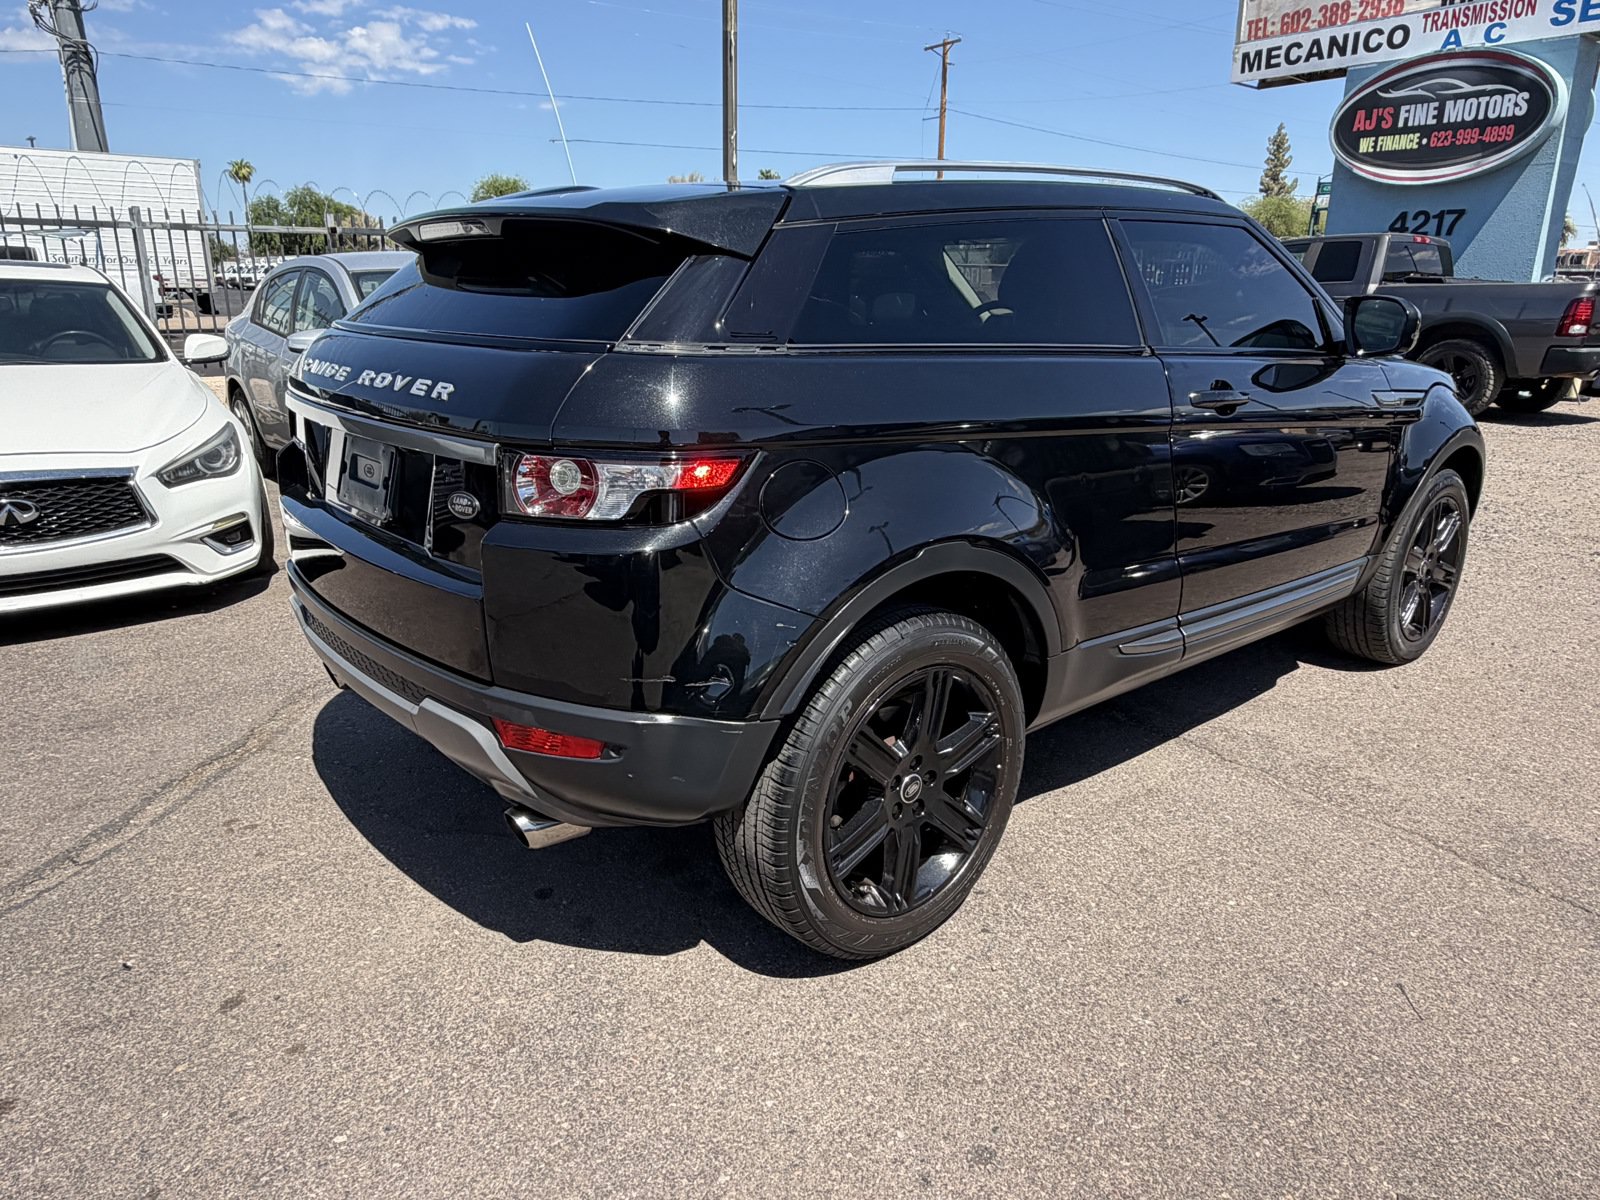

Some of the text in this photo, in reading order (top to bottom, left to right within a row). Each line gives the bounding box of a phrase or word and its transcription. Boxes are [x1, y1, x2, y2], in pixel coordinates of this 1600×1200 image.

[1246, 17, 1276, 41] TEL:
[1422, 0, 1538, 33] TRANSMISSION
[1240, 24, 1411, 74] MECANICO
[1352, 91, 1530, 132] AJ'S FINE MOTORS
[1358, 124, 1515, 153] WE FINANCE 623-999-4899
[1388, 209, 1467, 236] 4217
[356, 369, 456, 401] ROVER
